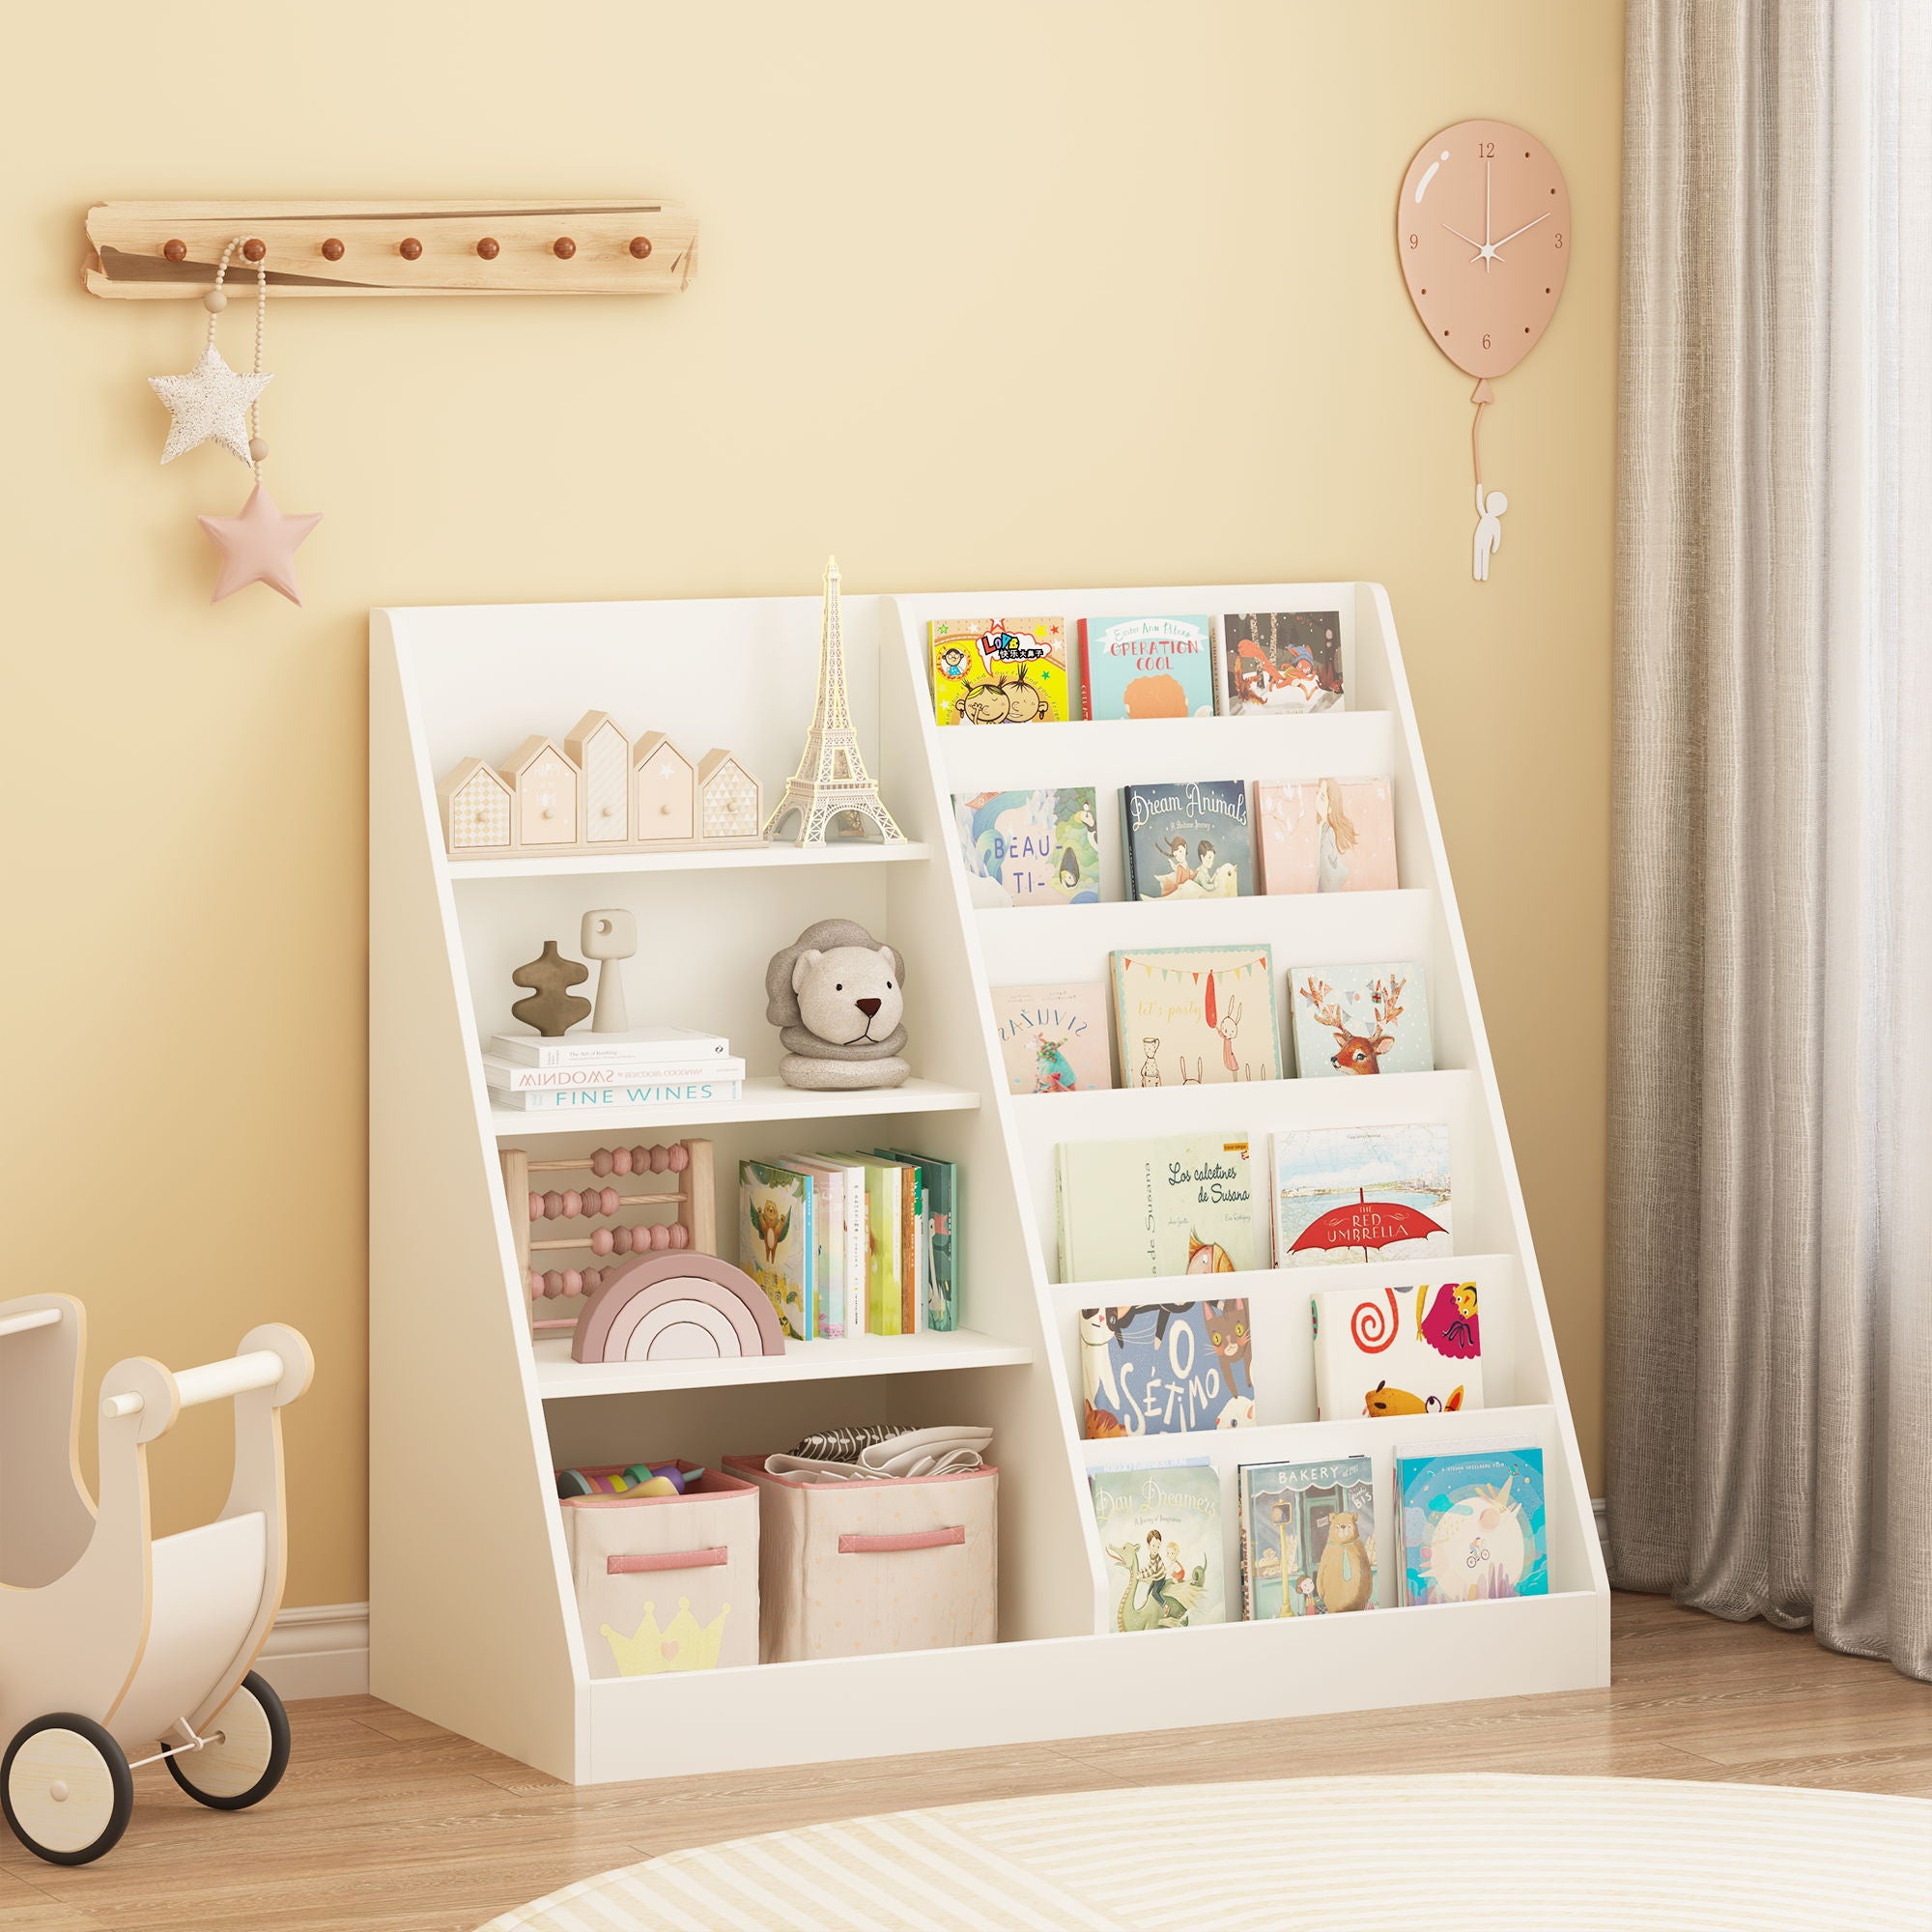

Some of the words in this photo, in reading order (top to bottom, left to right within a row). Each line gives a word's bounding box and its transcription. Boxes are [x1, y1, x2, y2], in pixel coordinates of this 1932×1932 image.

[1478, 142, 1495, 158] 12
[1409, 234, 1419, 250] 9
[1554, 233, 1563, 249] 3
[1482, 333, 1492, 350] 6
[1110, 639, 1199, 657] OPERATION
[1136, 656, 1175, 671] COOL
[1130, 790, 1182, 832] Dream
[1185, 781, 1247, 826] Animals
[994, 835, 1064, 860] BEAU-
[1012, 871, 1046, 894] TI-
[555, 1089, 614, 1106] FINE
[627, 1084, 713, 1103] WINES
[1168, 1161, 1191, 1185] Los
[1194, 1162, 1237, 1181] calcetines
[1198, 1186, 1208, 1204] de
[1210, 1183, 1250, 1204] Susana
[1352, 1213, 1382, 1228] RED
[1326, 1224, 1409, 1243] UMBRELLA
[1169, 1319, 1195, 1379] O
[1278, 1465, 1340, 1485] BAKERY
[1094, 1486, 1133, 1523] Day
